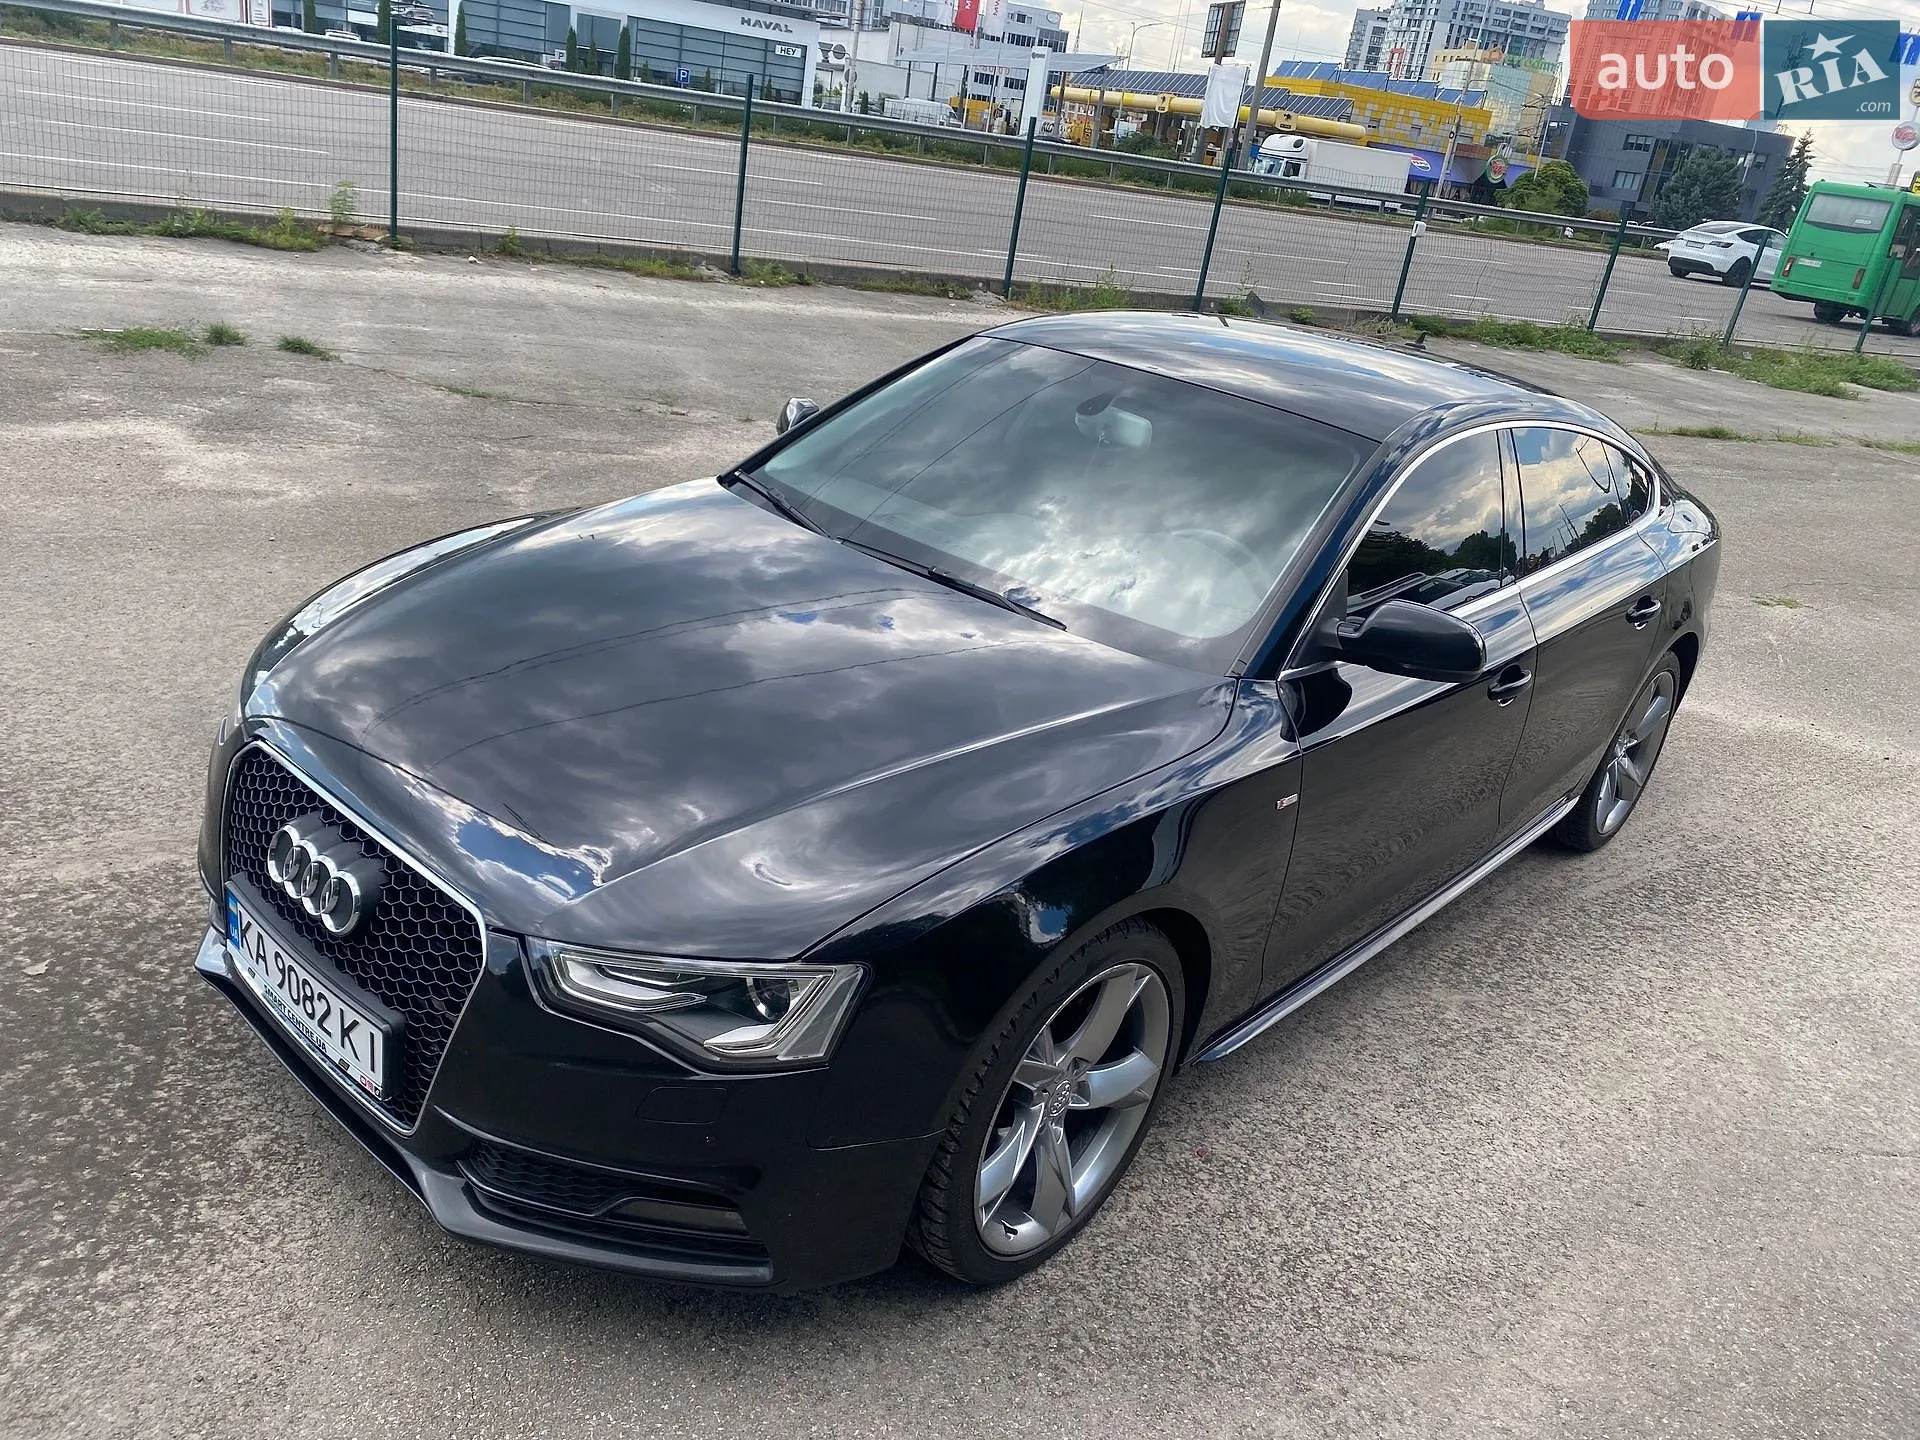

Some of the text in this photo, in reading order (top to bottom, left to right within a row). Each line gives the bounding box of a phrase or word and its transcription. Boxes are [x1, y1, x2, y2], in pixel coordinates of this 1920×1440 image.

[740, 16, 793, 33] HAVAL
[780, 46, 797, 56] HEY
[238, 909, 376, 1074] KA 9082 KI
